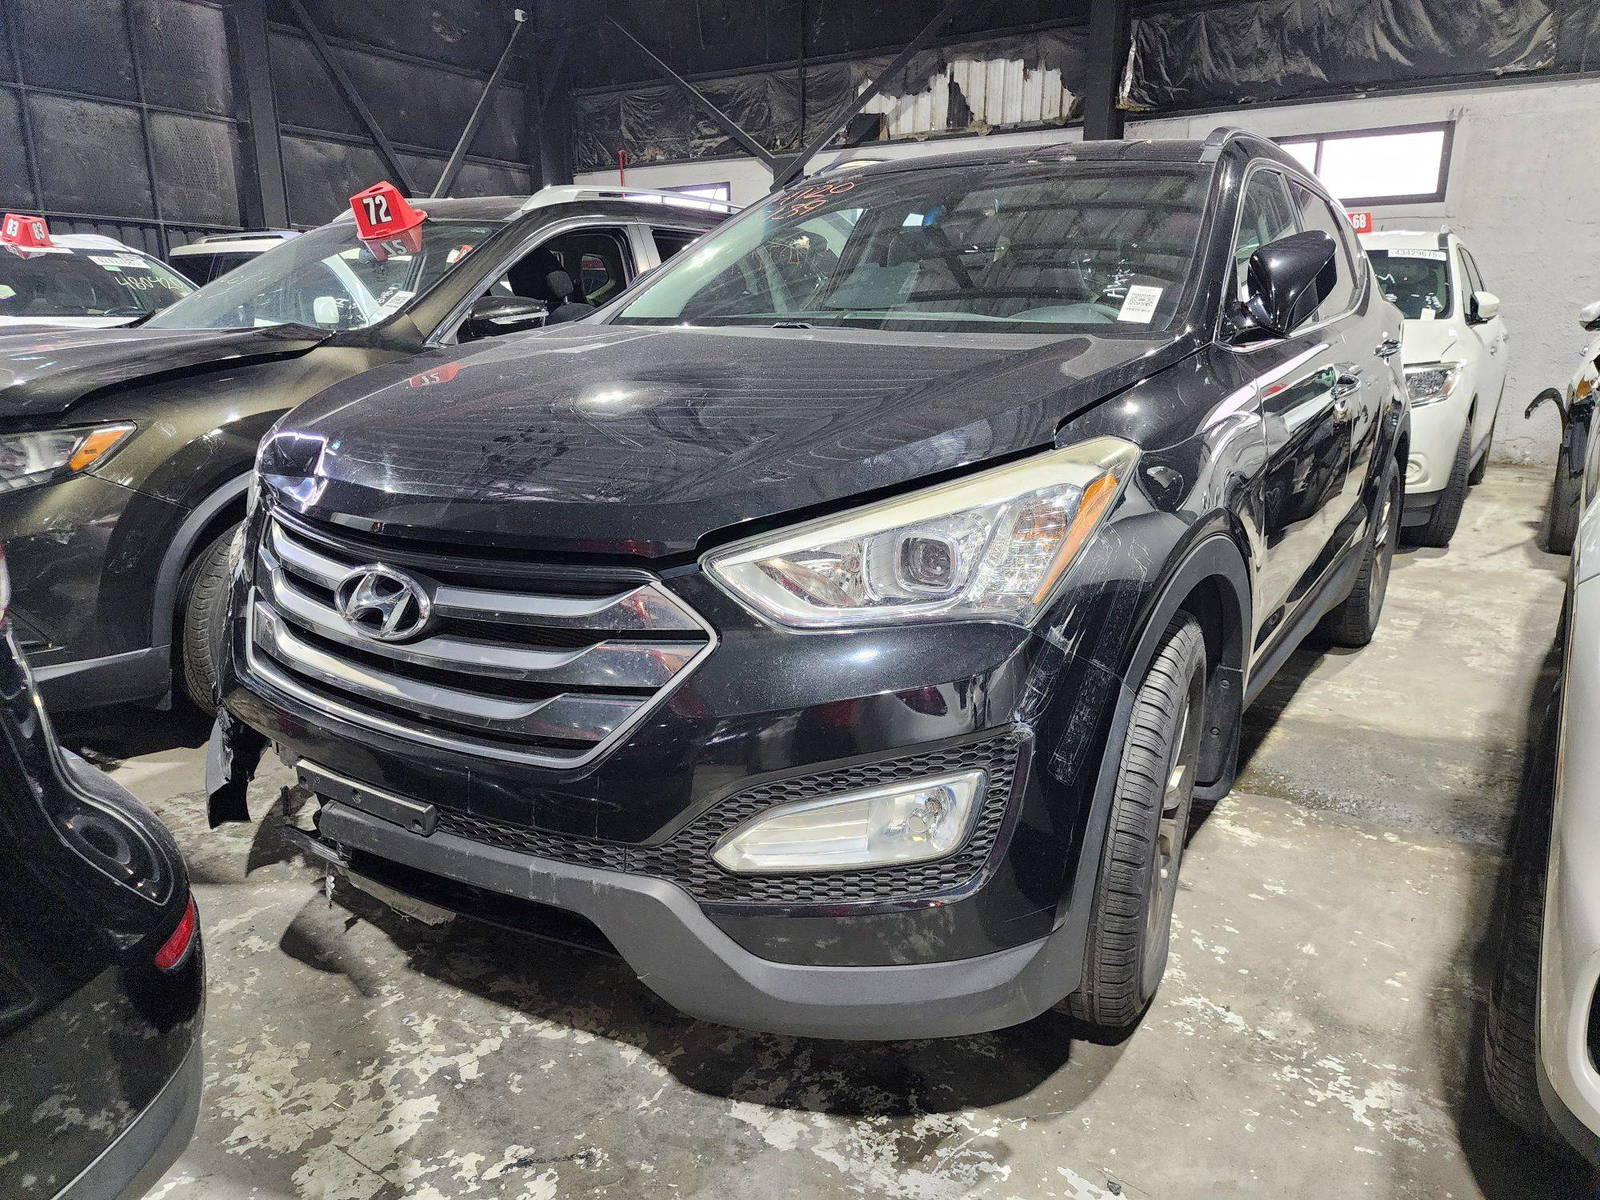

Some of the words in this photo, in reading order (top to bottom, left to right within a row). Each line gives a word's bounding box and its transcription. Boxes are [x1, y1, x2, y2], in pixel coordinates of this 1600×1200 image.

[363, 194, 392, 226] 72
[6, 218, 19, 237] 83
[32, 221, 46, 240] 83
[1353, 213, 1366, 229] 68
